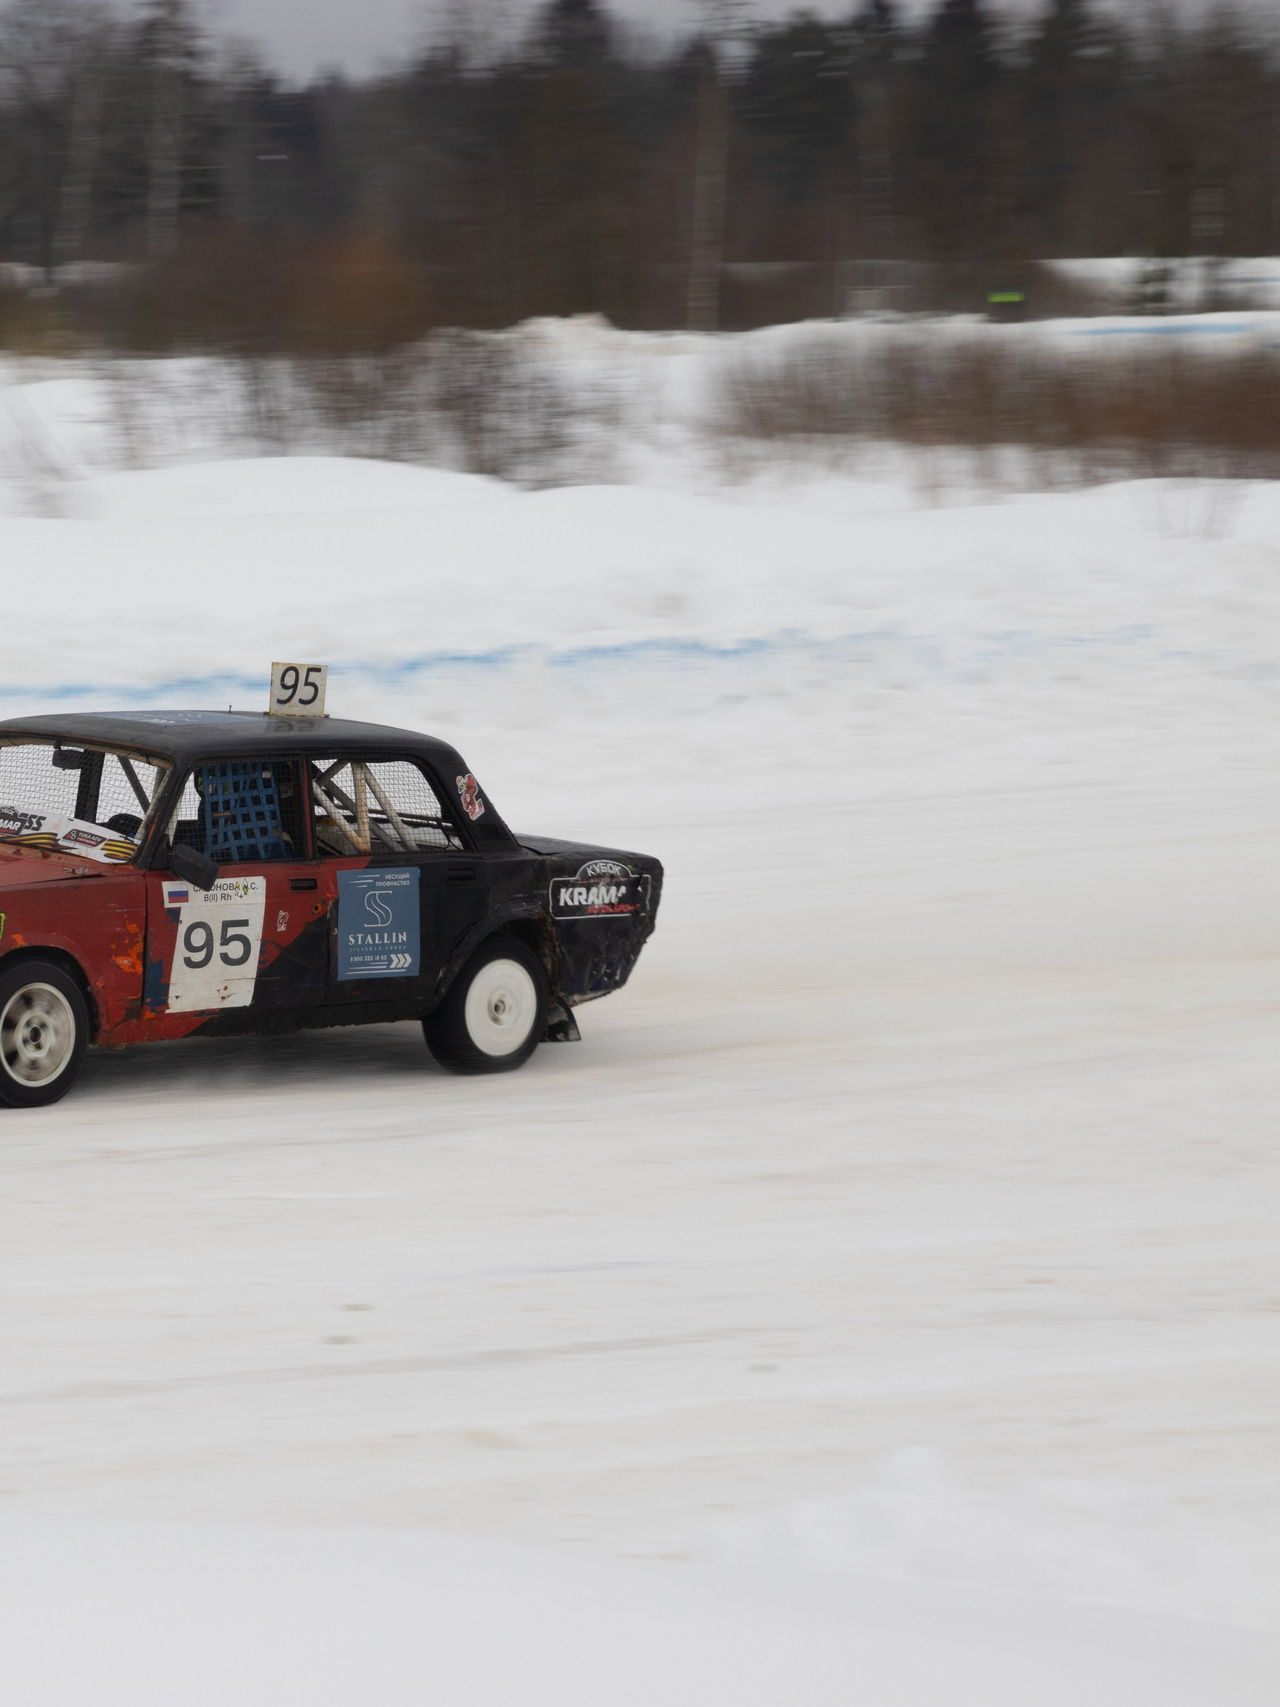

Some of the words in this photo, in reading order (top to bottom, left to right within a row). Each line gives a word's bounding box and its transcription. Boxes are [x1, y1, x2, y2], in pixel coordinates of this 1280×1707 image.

[276, 666, 322, 705] 95
[586, 863, 622, 877] КУБОК
[221, 893, 232, 901] Rh
[559, 885, 627, 906] KRAM
[183, 918, 252, 969] 95
[348, 932, 407, 945] STALLIN
